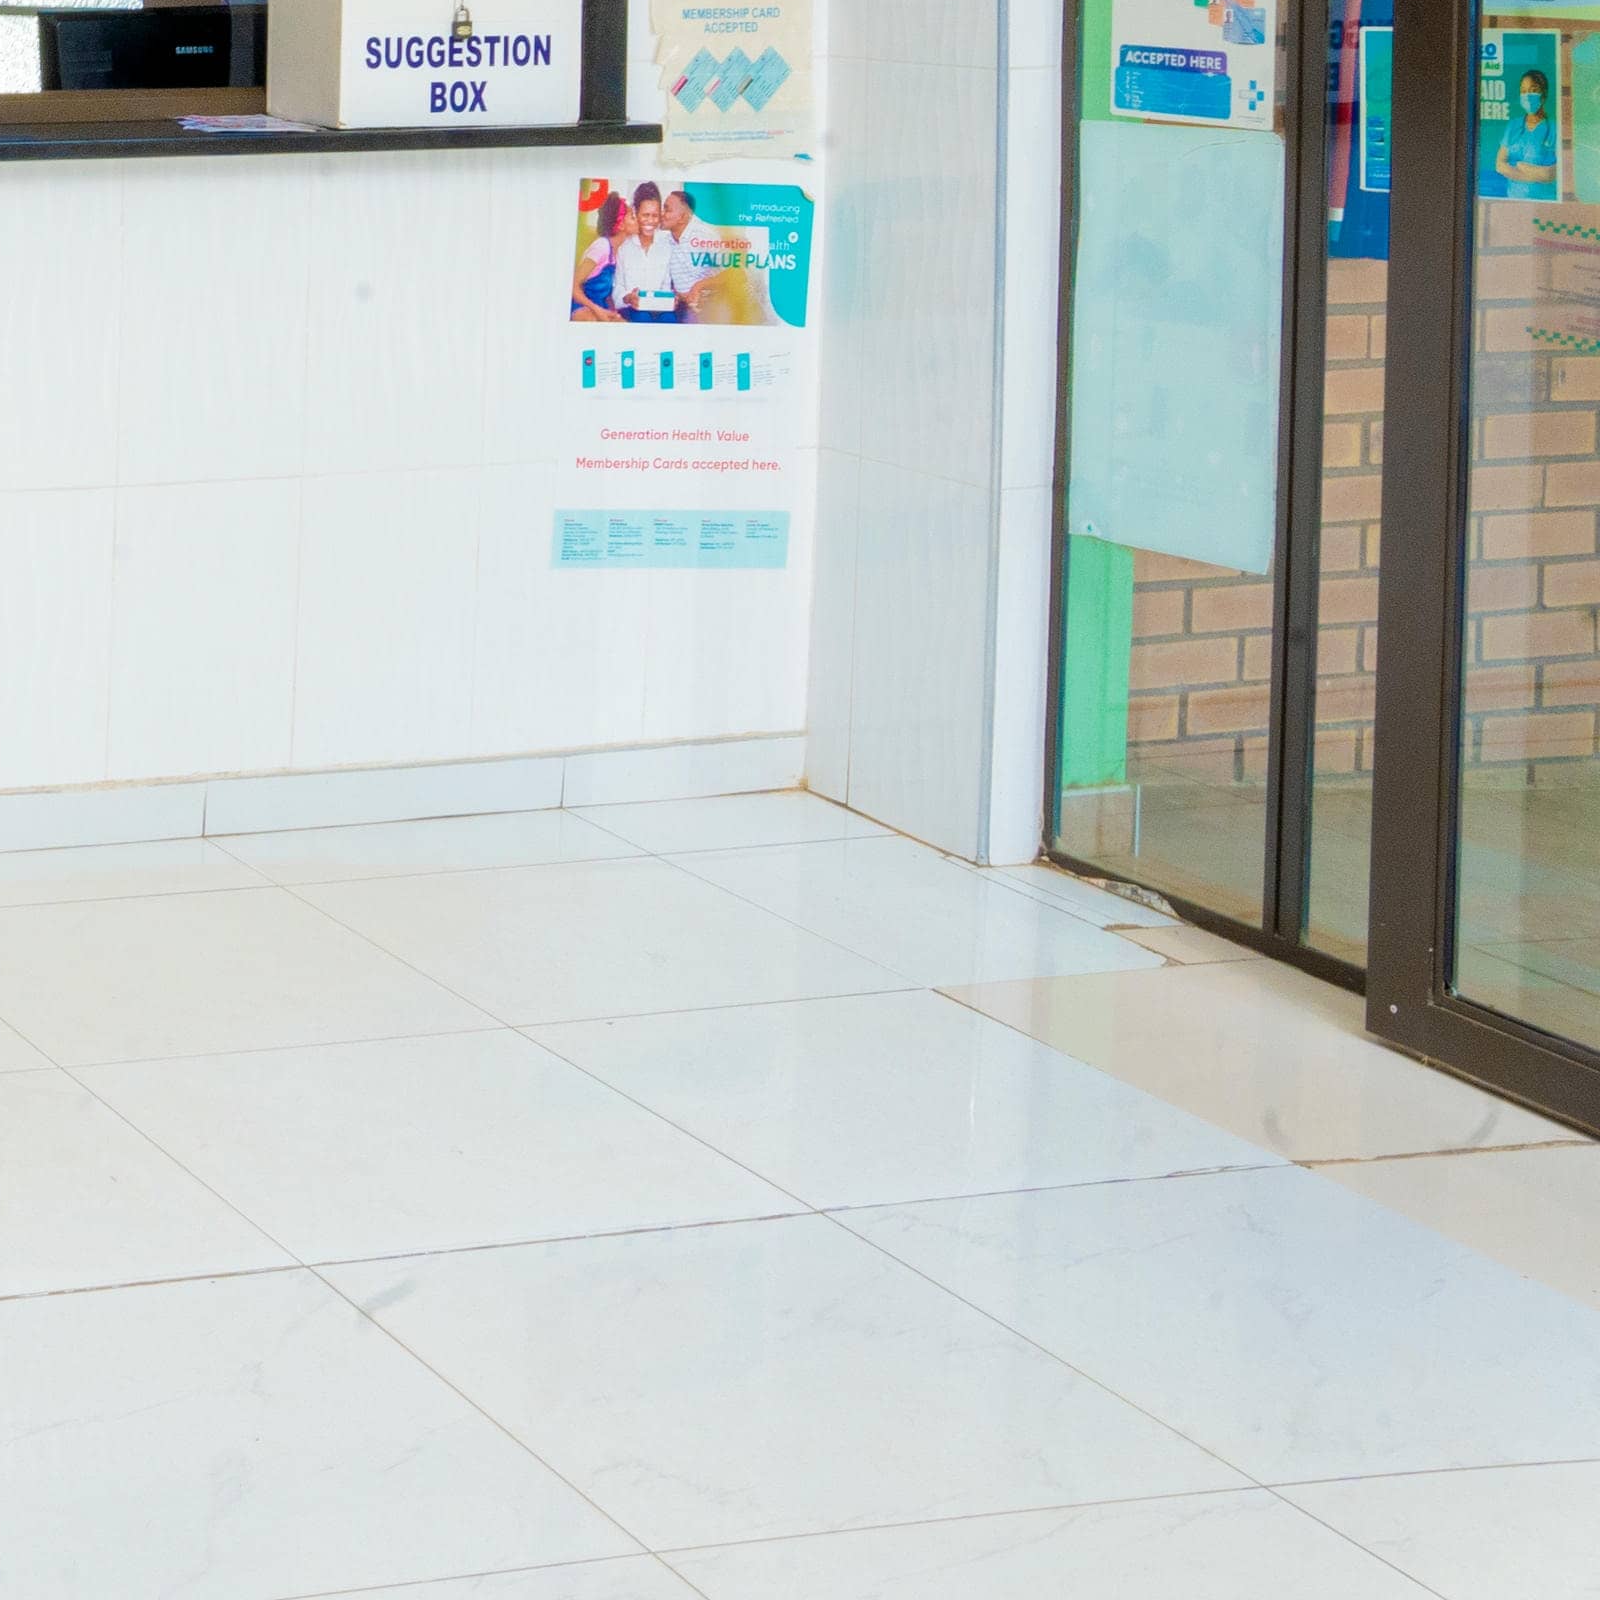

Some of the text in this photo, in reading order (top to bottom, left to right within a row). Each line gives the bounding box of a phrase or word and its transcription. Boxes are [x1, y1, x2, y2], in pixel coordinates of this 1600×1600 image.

[682, 6, 781, 20] MEMBERSHIP CARD
[704, 21, 759, 34] ACCEPTED
[365, 35, 552, 69] SUGGESTION
[1125, 50, 1223, 70] ACCEPTED HERE
[430, 81, 488, 113] BOX
[690, 237, 752, 250] Generation
[690, 252, 797, 270] VALUE PLANS
[600, 428, 750, 442] Generation Health Value
[576, 457, 782, 473] Membership Cards accepted here.
